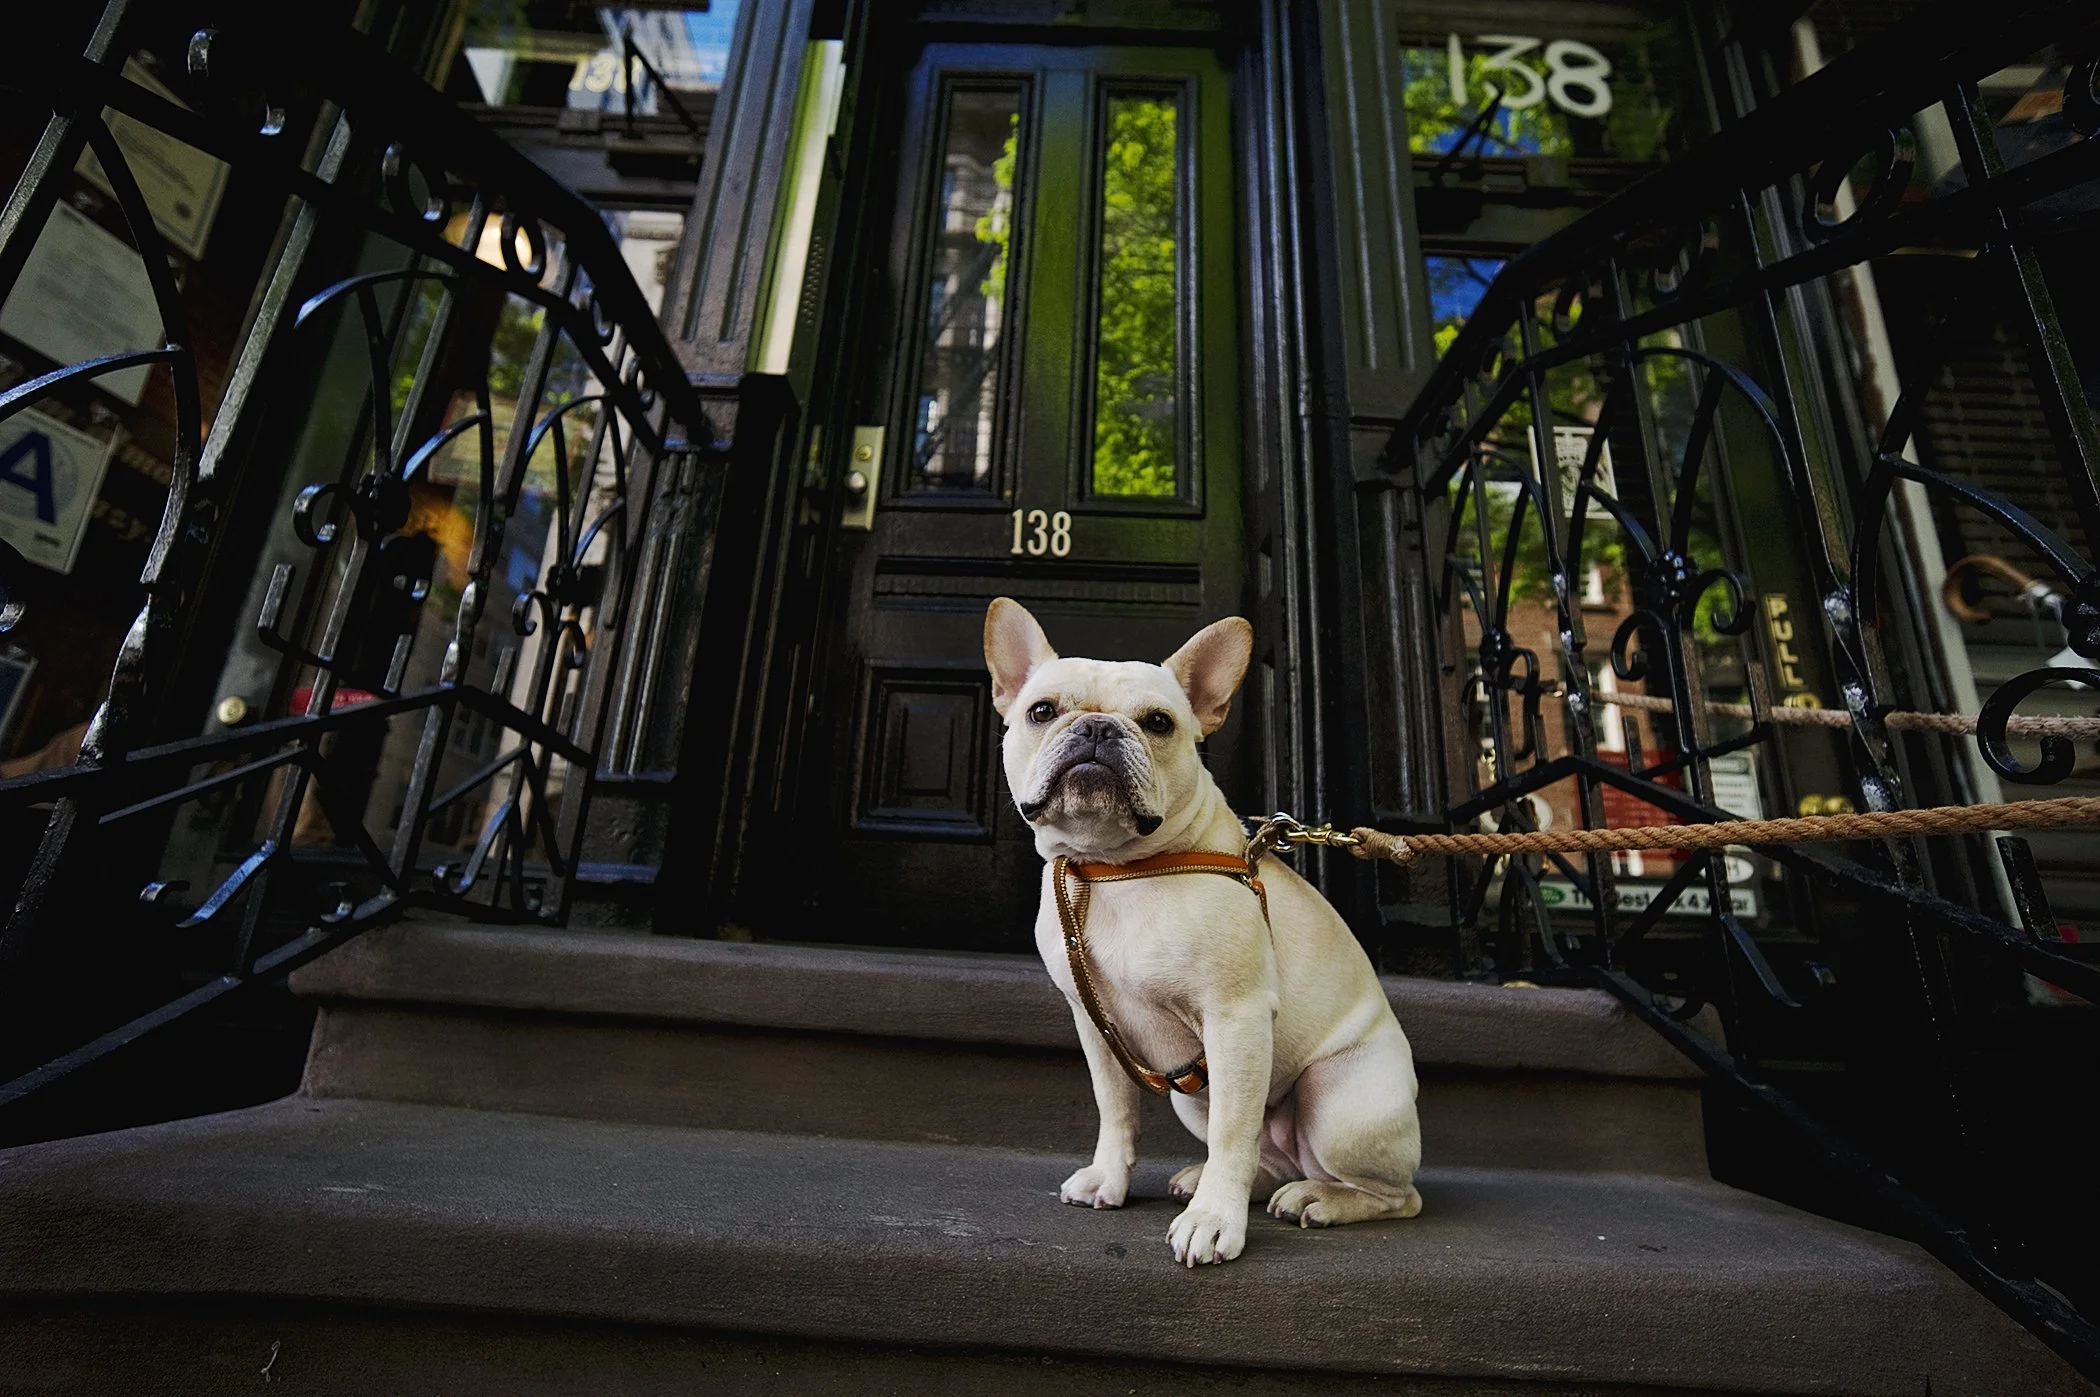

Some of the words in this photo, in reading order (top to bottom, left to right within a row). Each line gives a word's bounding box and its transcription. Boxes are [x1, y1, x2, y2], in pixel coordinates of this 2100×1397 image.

[1447, 32, 1613, 118] 138
[0, 431, 55, 524] A
[1010, 508, 1072, 557] 138
[1767, 596, 1804, 687] PULL
